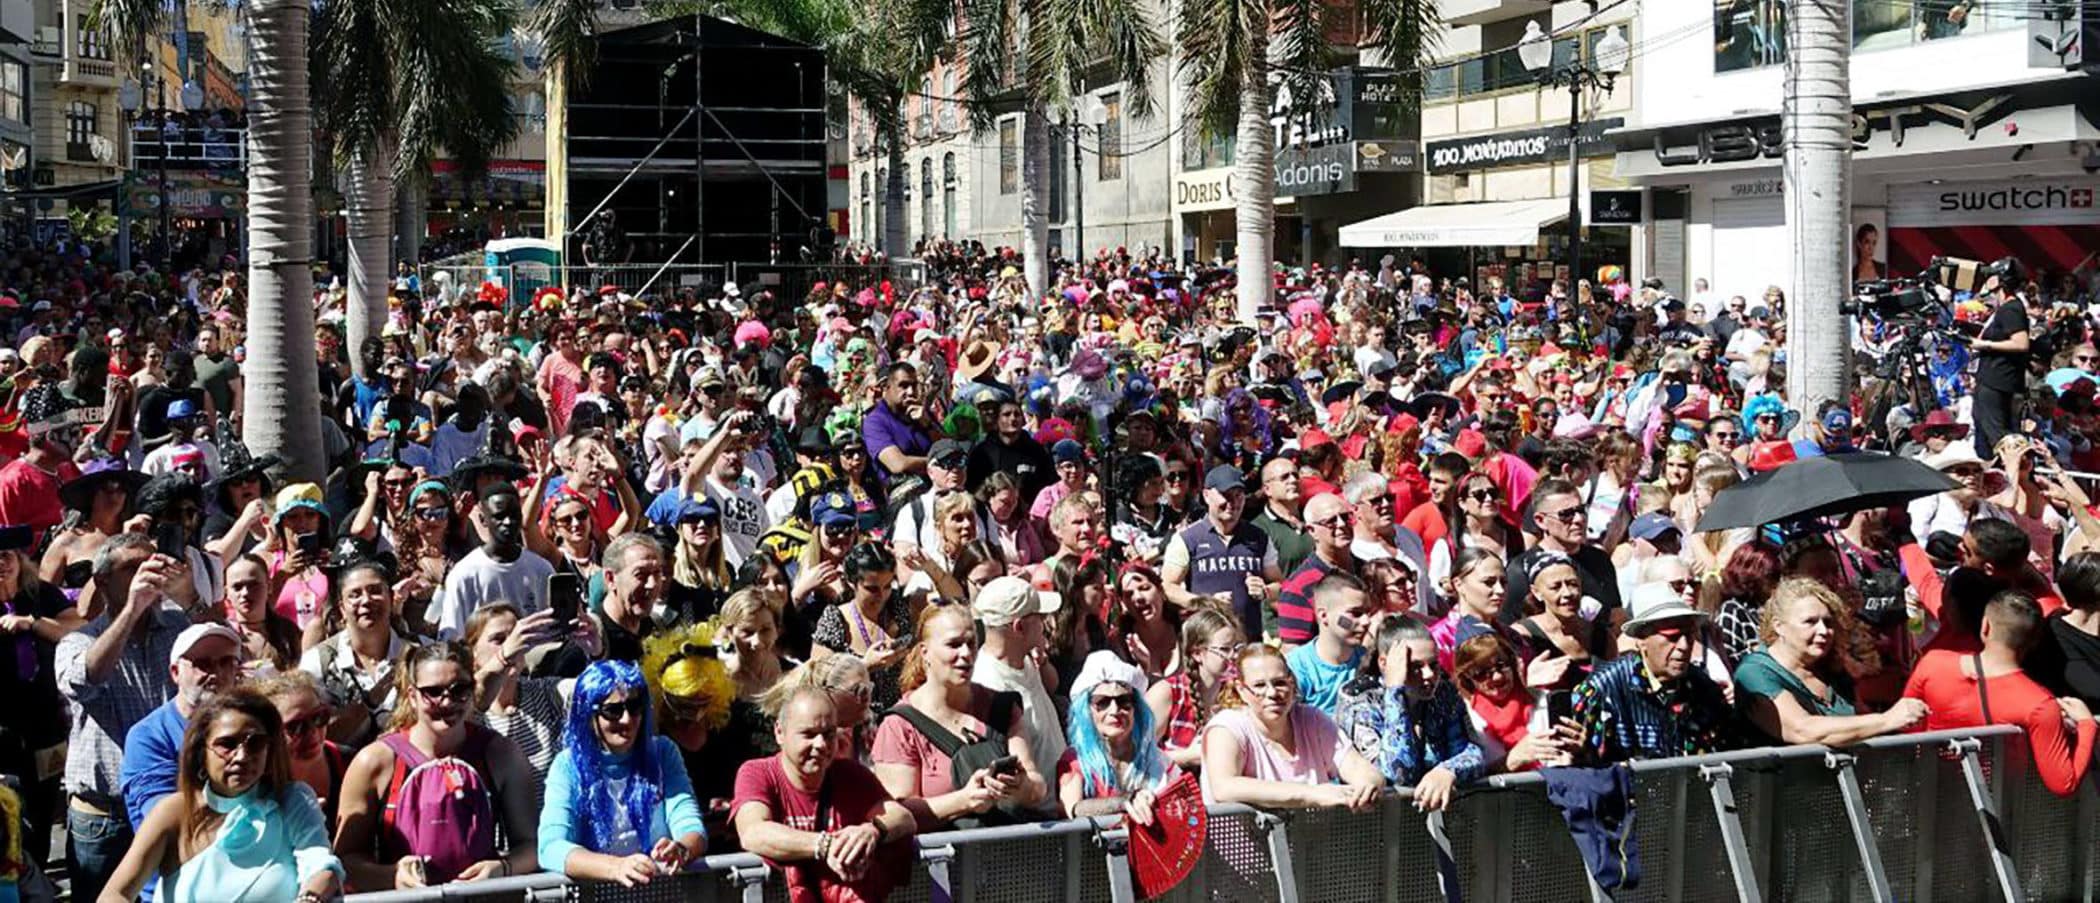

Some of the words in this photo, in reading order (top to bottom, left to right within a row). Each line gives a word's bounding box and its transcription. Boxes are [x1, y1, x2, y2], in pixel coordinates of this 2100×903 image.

[1433, 146, 1459, 167] 100
[1460, 135, 1546, 164] MONTADITOS
[1177, 179, 1221, 205] DORIS
[1939, 184, 2067, 211] swatch
[1197, 555, 1262, 573] HACKETT
